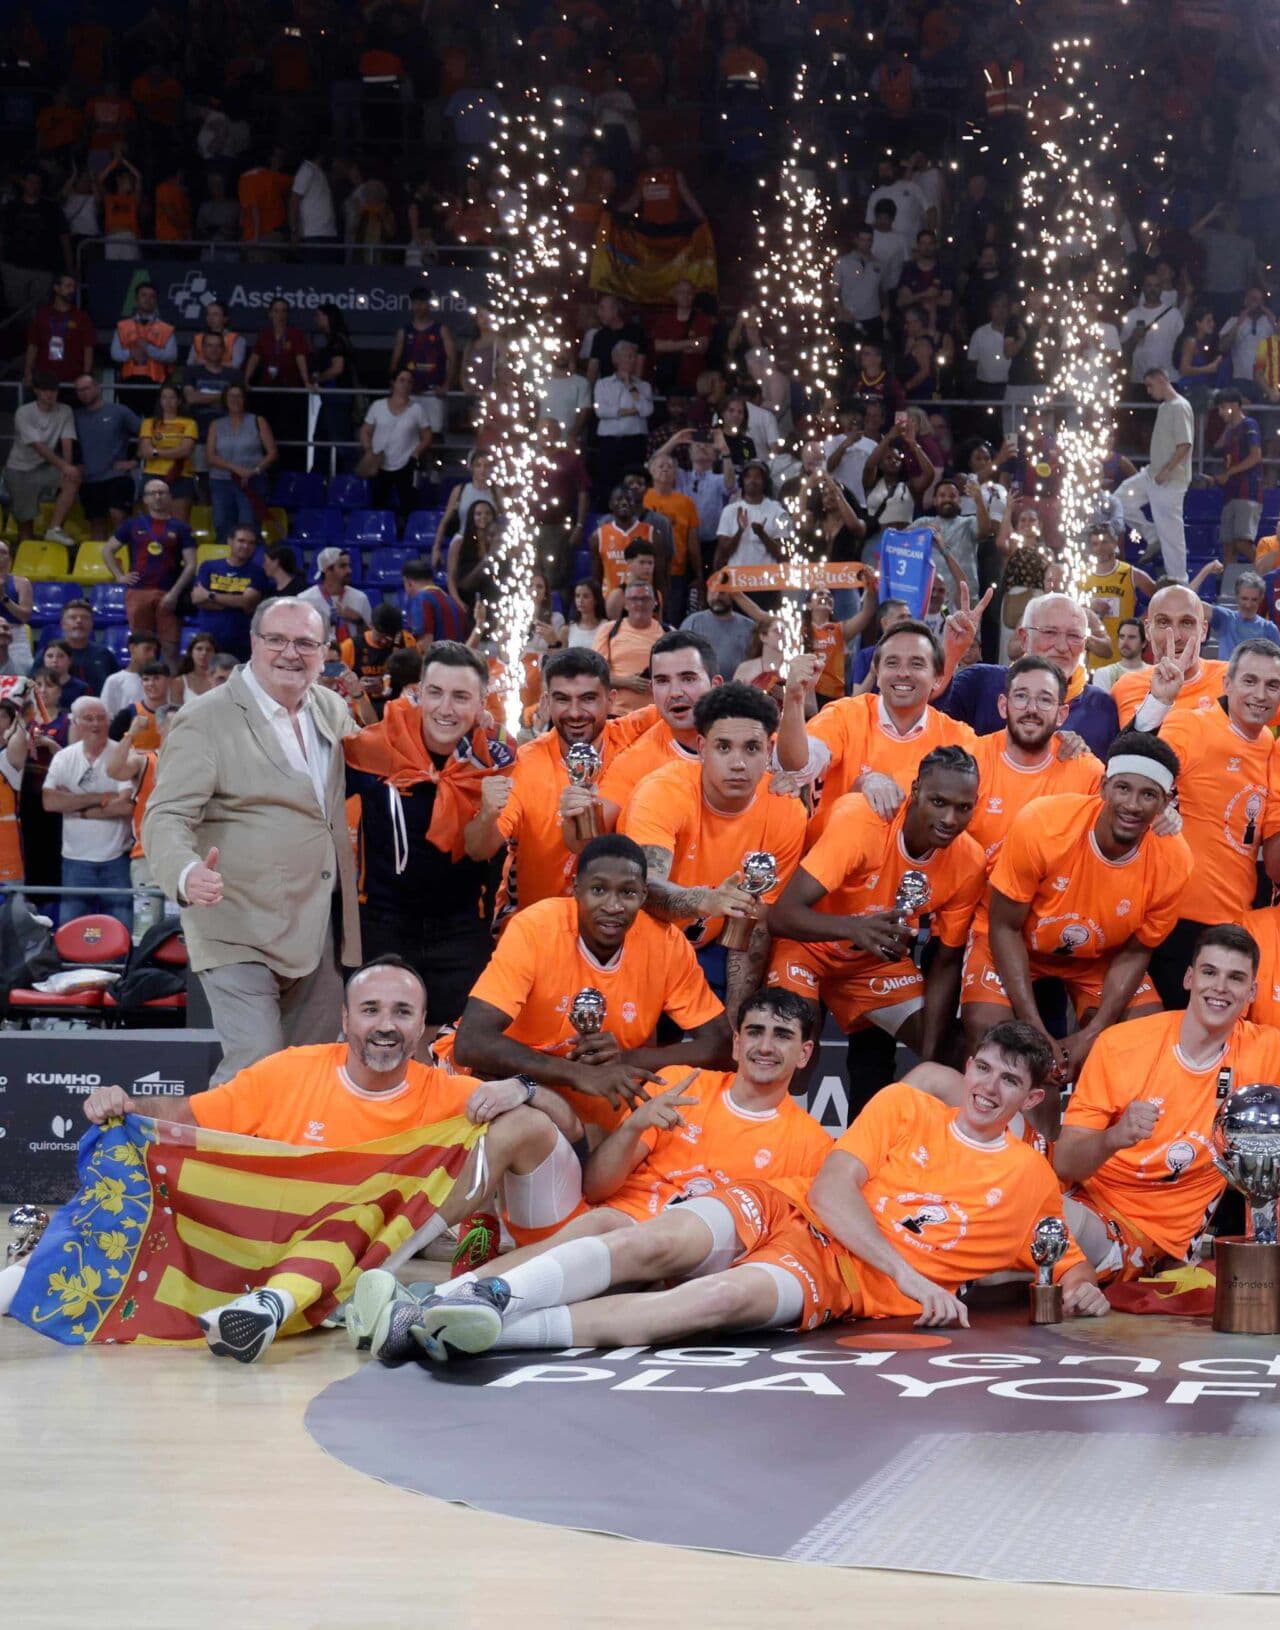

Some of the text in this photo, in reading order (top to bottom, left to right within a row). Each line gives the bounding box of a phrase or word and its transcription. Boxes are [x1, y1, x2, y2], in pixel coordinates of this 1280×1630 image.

[896, 560, 907, 576] 3
[788, 565, 857, 590] ogués
[869, 973, 924, 995] Midea
[26, 1072, 101, 1085] KUMHO
[132, 1083, 185, 1096] LOTUS
